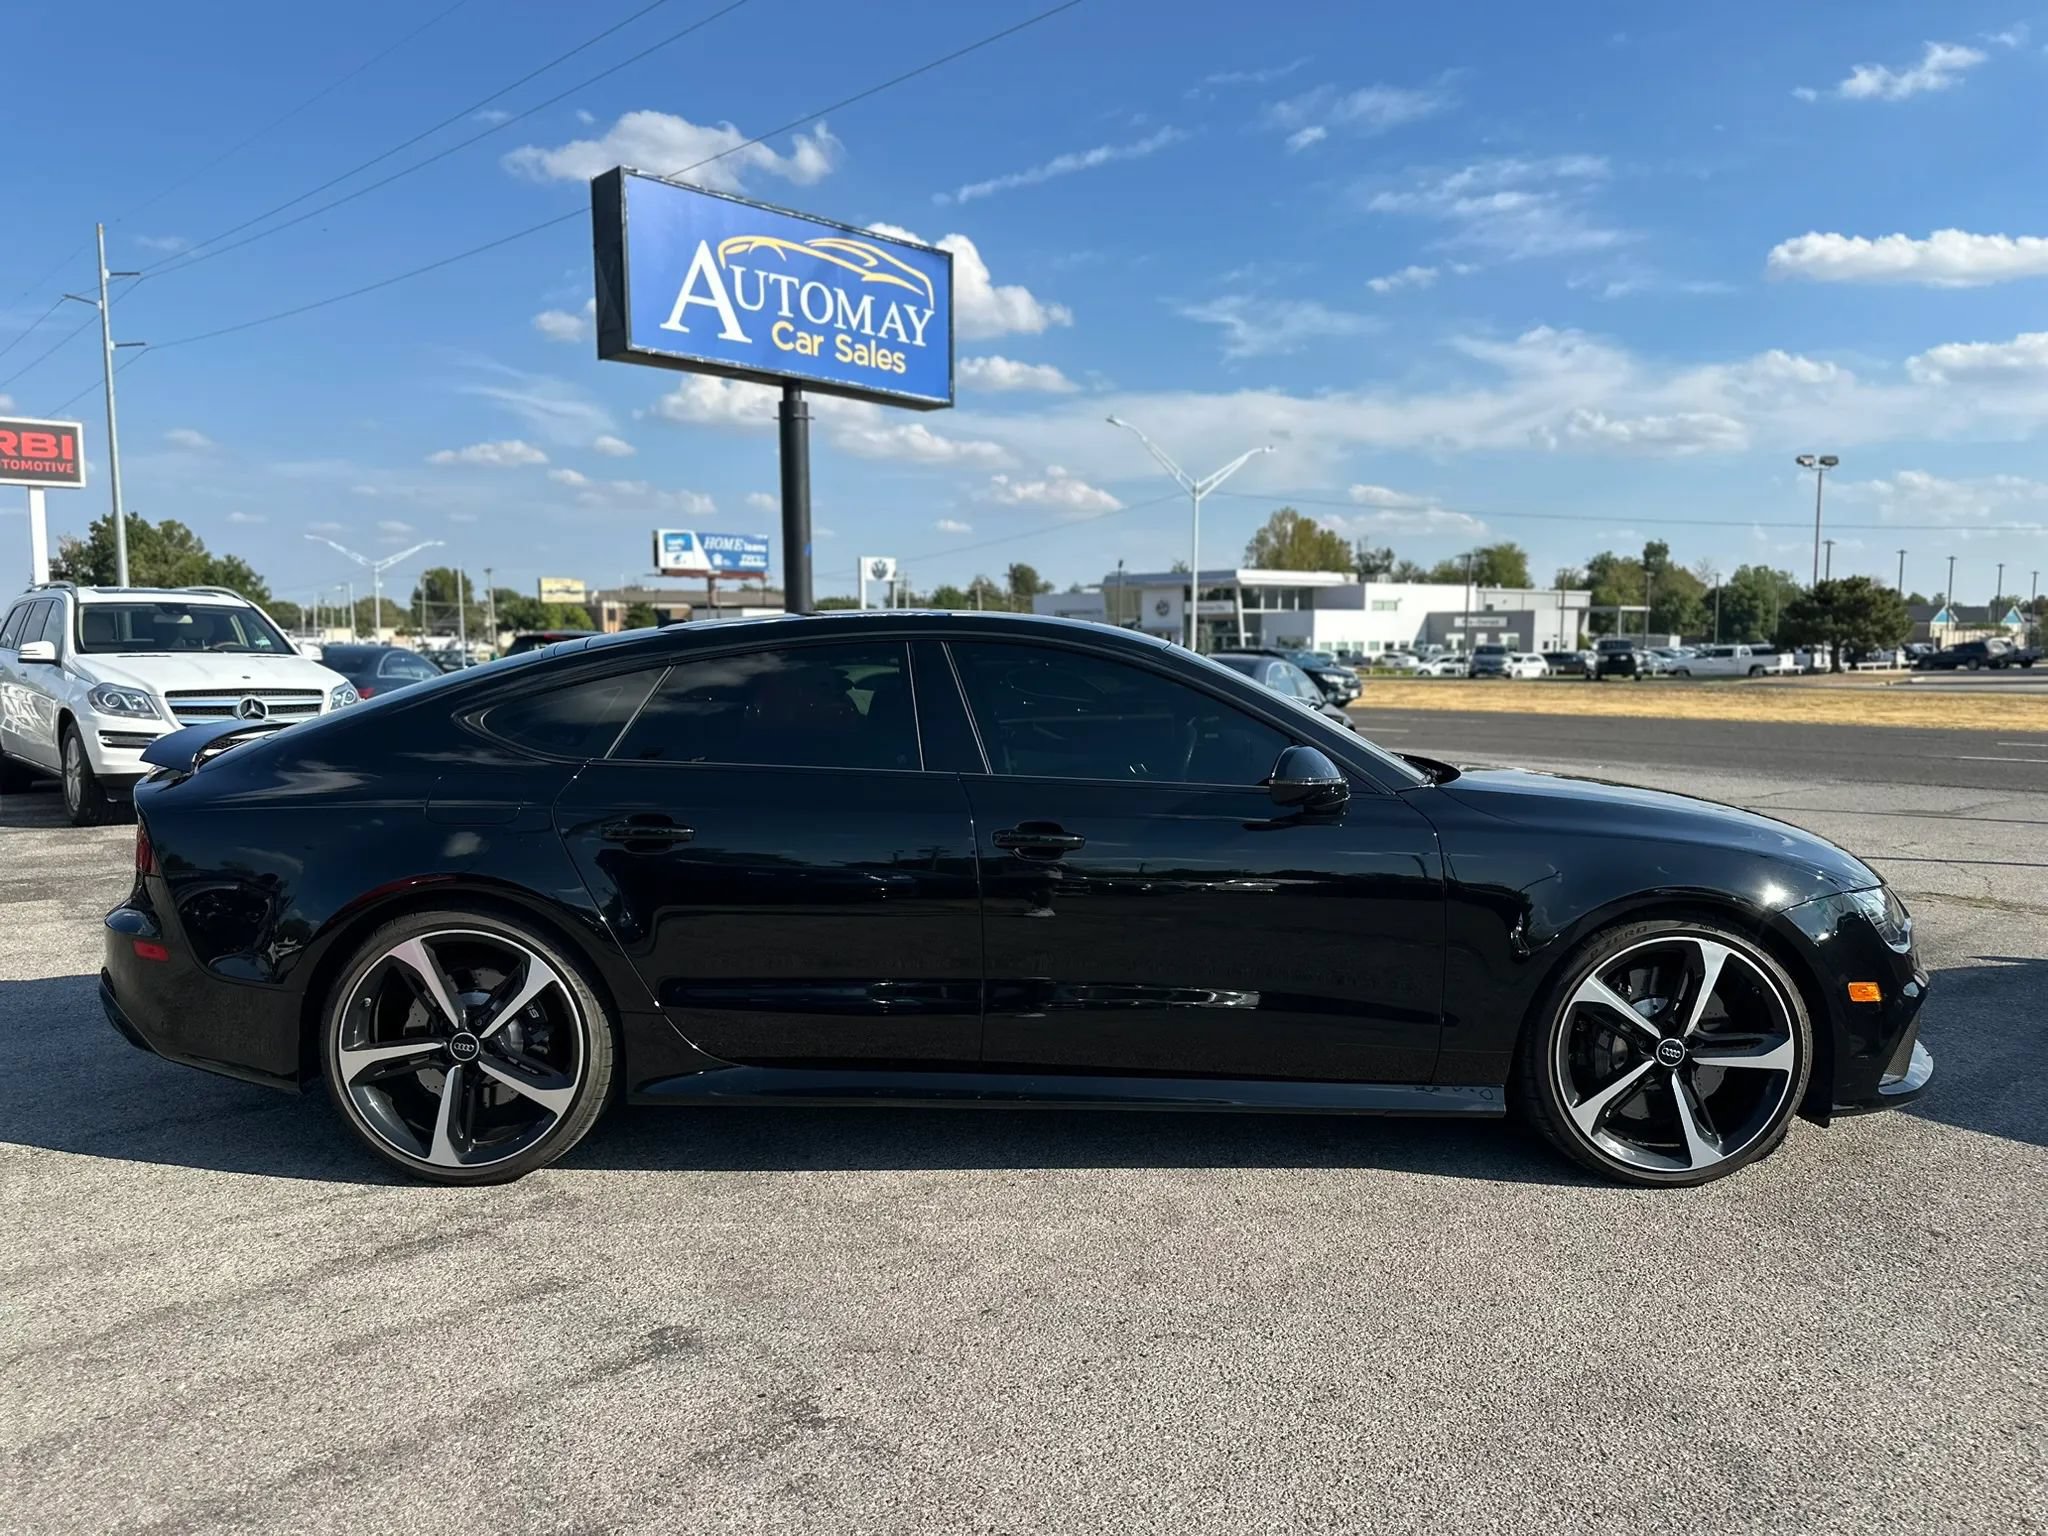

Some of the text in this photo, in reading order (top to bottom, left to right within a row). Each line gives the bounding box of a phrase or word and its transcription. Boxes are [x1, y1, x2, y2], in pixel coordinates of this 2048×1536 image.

[660, 239, 936, 347] AUTOMAY
[771, 320, 907, 375] Car Sales
[0, 458, 74, 474] TOMOTIVE
[703, 536, 744, 552] HOME
